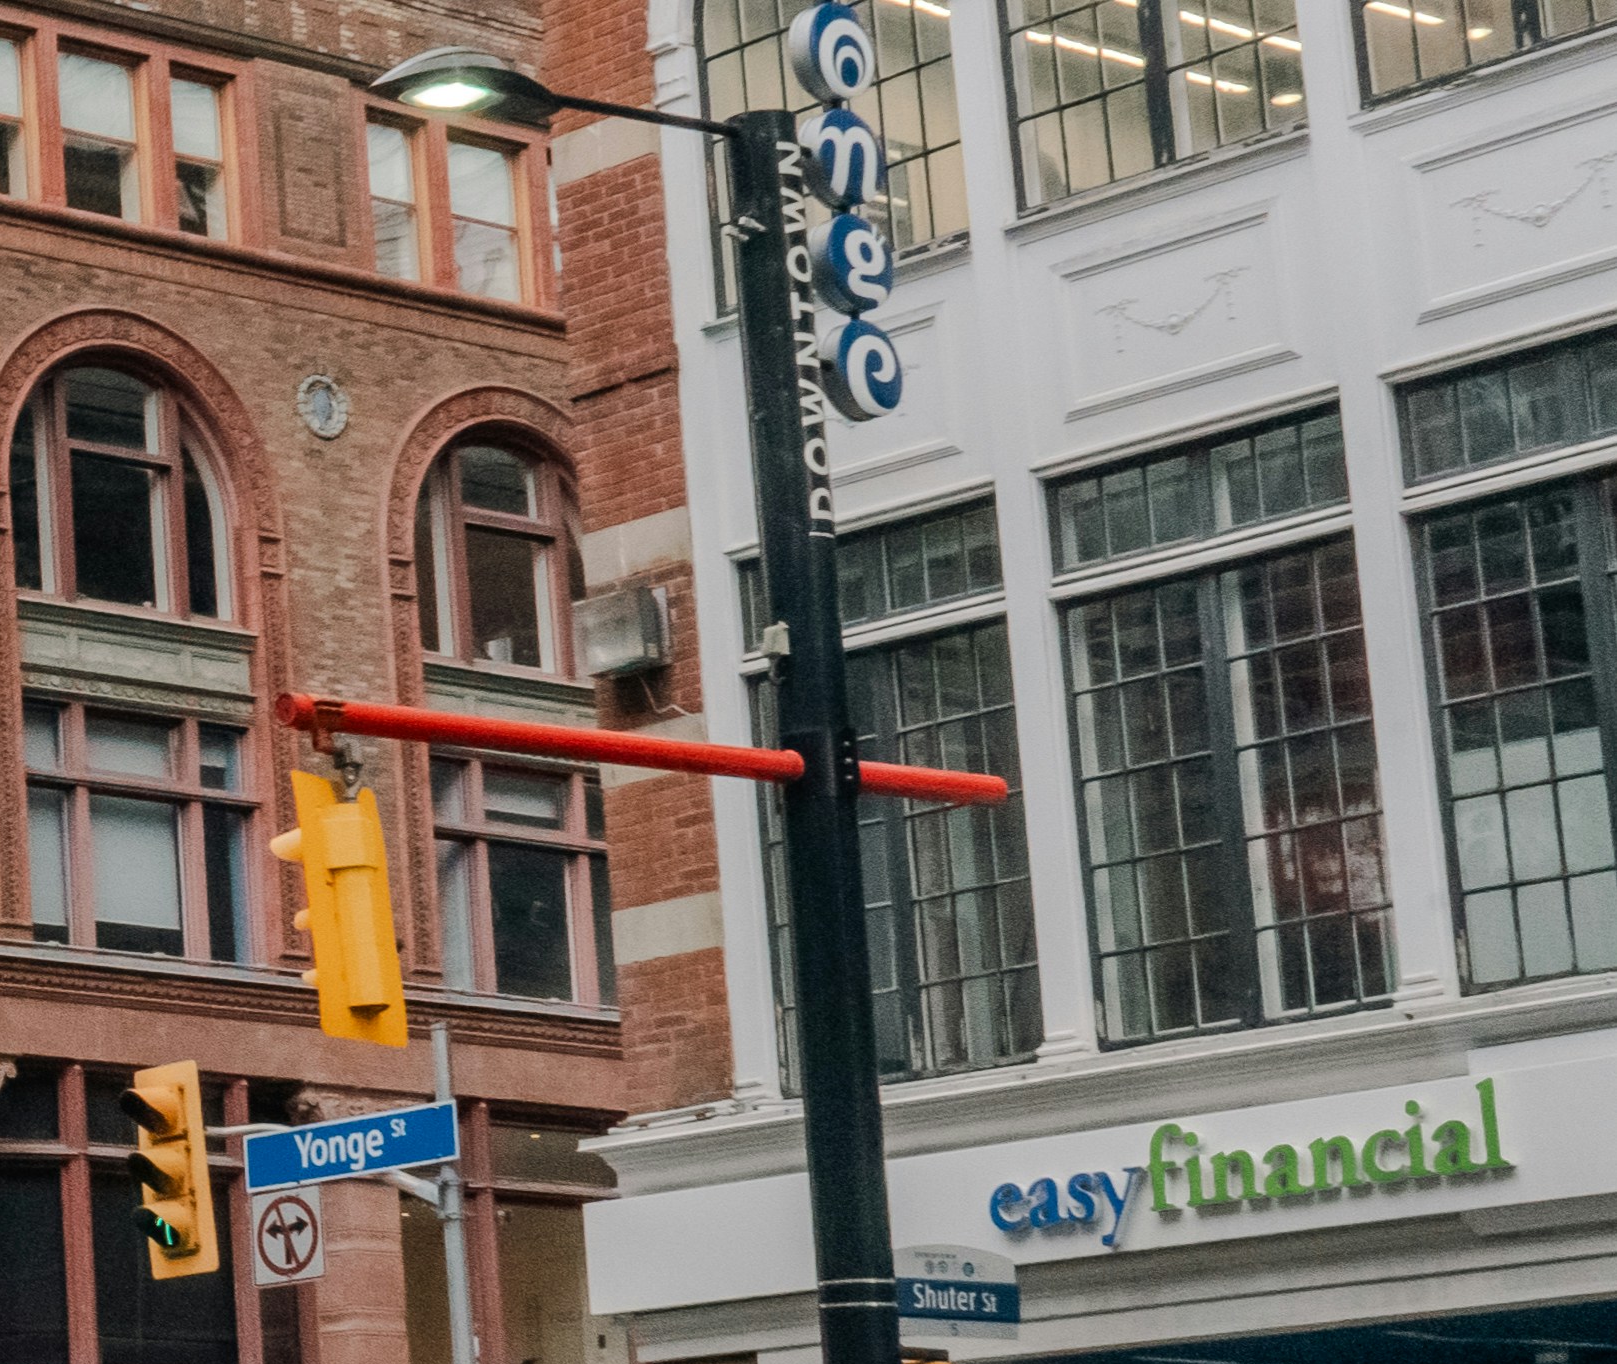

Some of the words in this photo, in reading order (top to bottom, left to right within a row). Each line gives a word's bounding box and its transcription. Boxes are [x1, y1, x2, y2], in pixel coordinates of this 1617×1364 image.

[775, 140, 834, 527] DOWNTOWN
[294, 1128, 384, 1172] Yonge
[389, 1118, 407, 1140] St
[912, 1282, 978, 1312] Shuter
[981, 1292, 998, 1313] St
